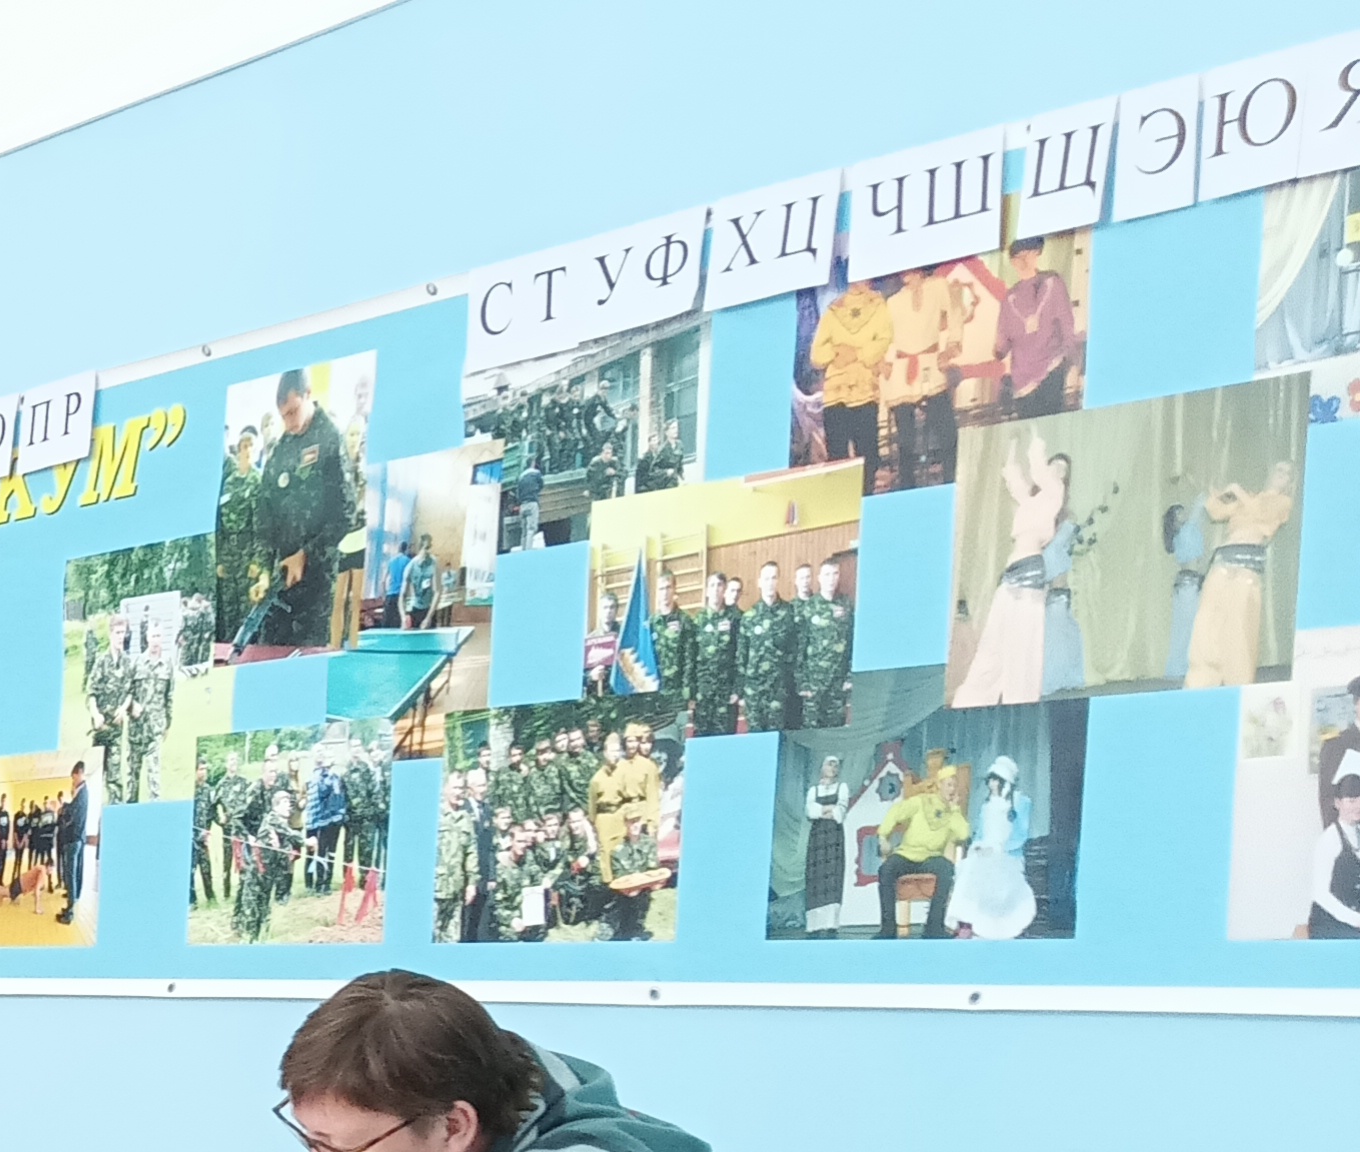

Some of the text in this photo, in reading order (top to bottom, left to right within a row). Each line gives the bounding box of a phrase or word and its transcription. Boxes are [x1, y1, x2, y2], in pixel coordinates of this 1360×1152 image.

[1026, 121, 1106, 199] Щ
[1135, 107, 1187, 176] Э
[1205, 77, 1298, 161] Ю
